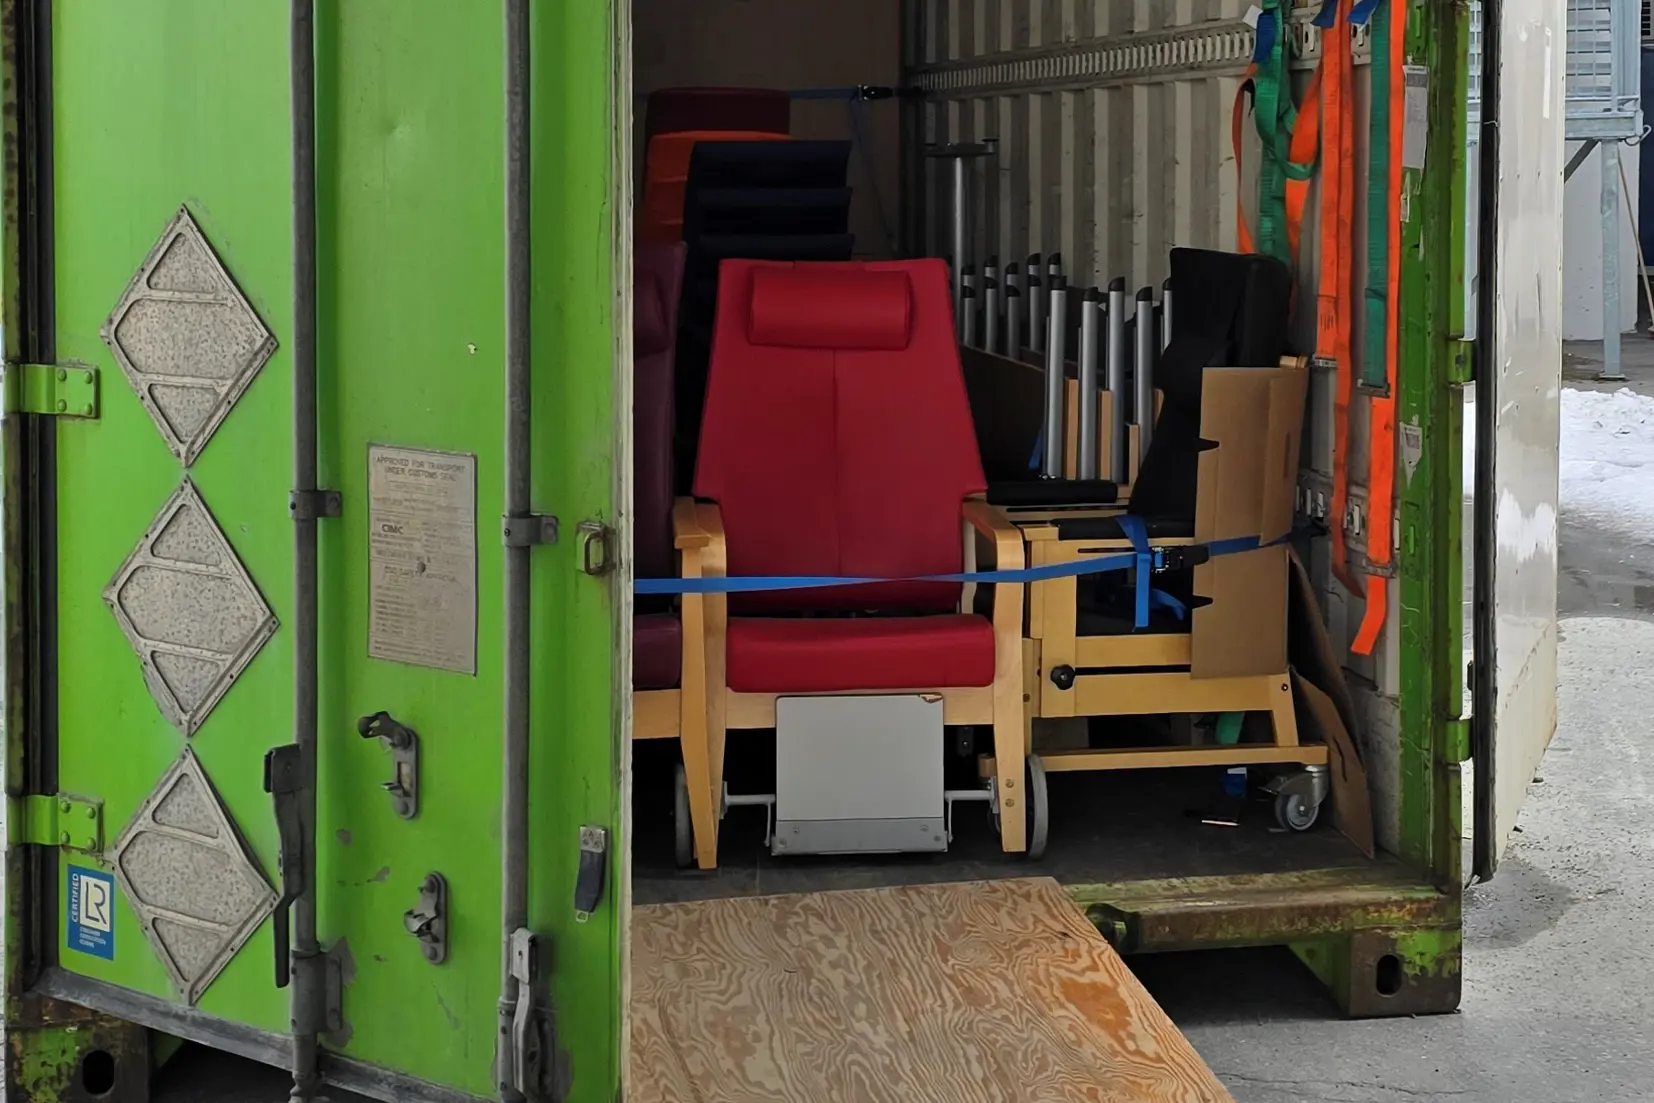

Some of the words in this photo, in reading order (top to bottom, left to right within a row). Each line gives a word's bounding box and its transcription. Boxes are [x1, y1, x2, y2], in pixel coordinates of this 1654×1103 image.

[377, 455, 409, 467] APPROVED
[412, 460, 424, 468] FOR
[428, 462, 465, 472] TRANSPORT
[385, 467, 405, 475] UNDER
[408, 468, 438, 479] CUSTOMS
